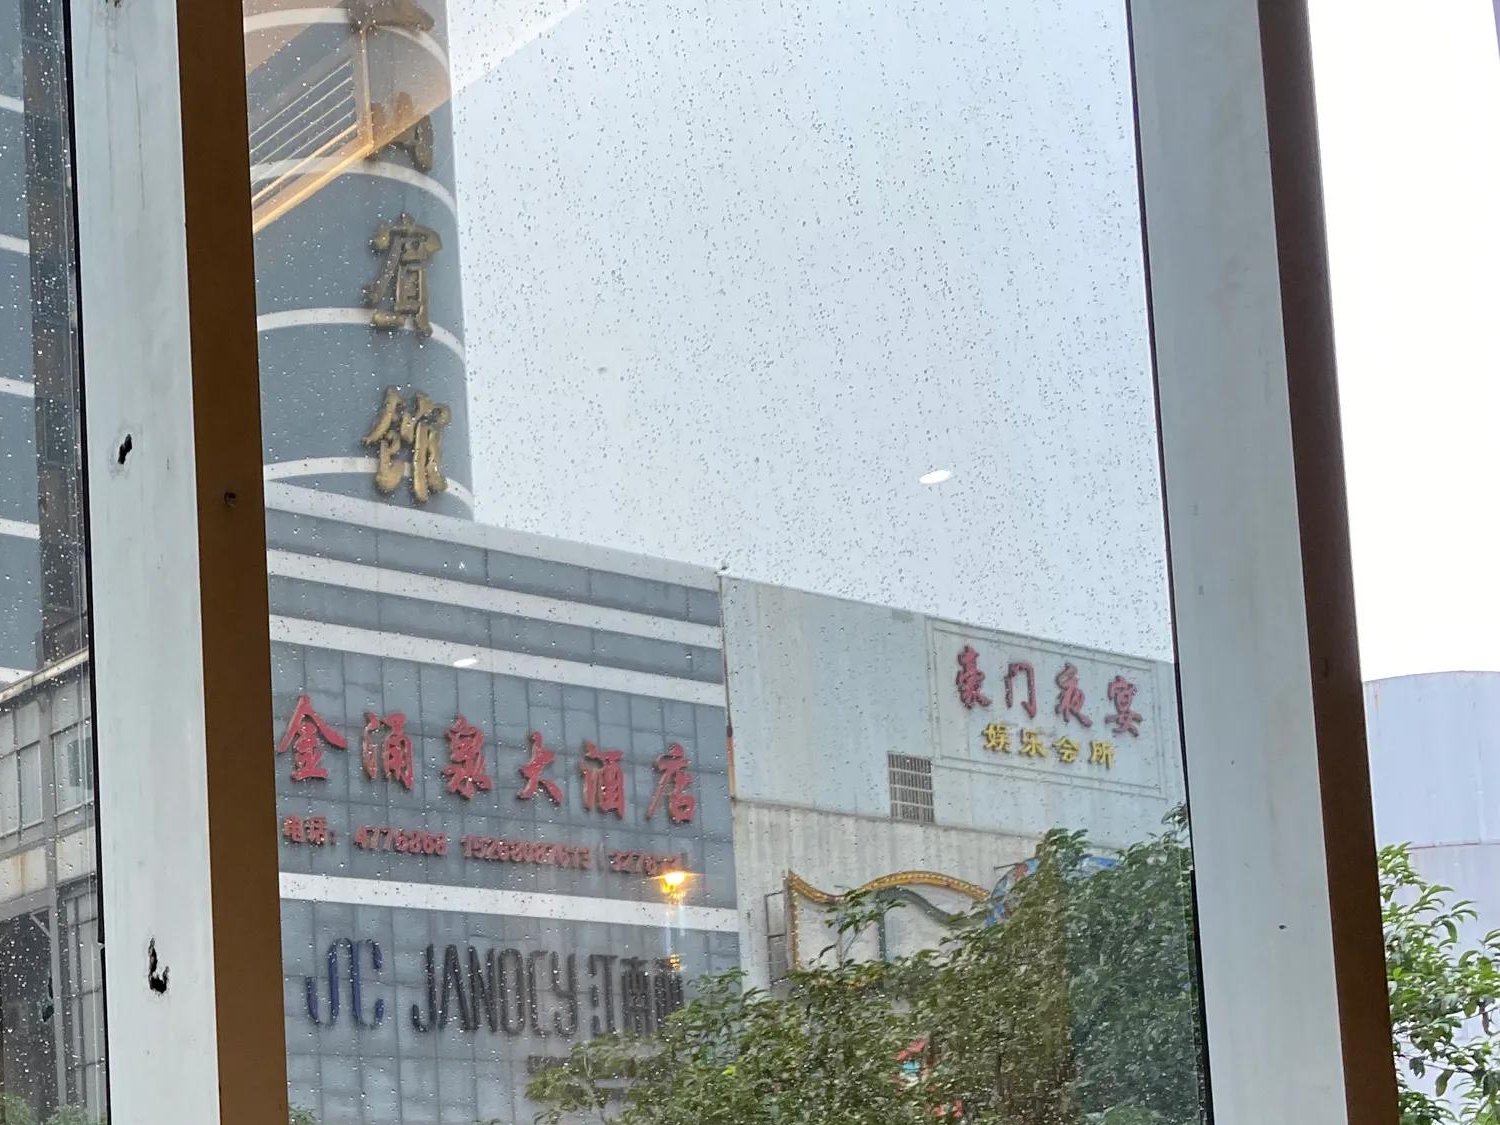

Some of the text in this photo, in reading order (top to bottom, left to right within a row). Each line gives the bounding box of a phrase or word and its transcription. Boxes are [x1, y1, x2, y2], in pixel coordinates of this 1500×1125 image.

[276, 694, 698, 824] 金涌泉大酒店
[981, 722, 1115, 770] 娱乐会所
